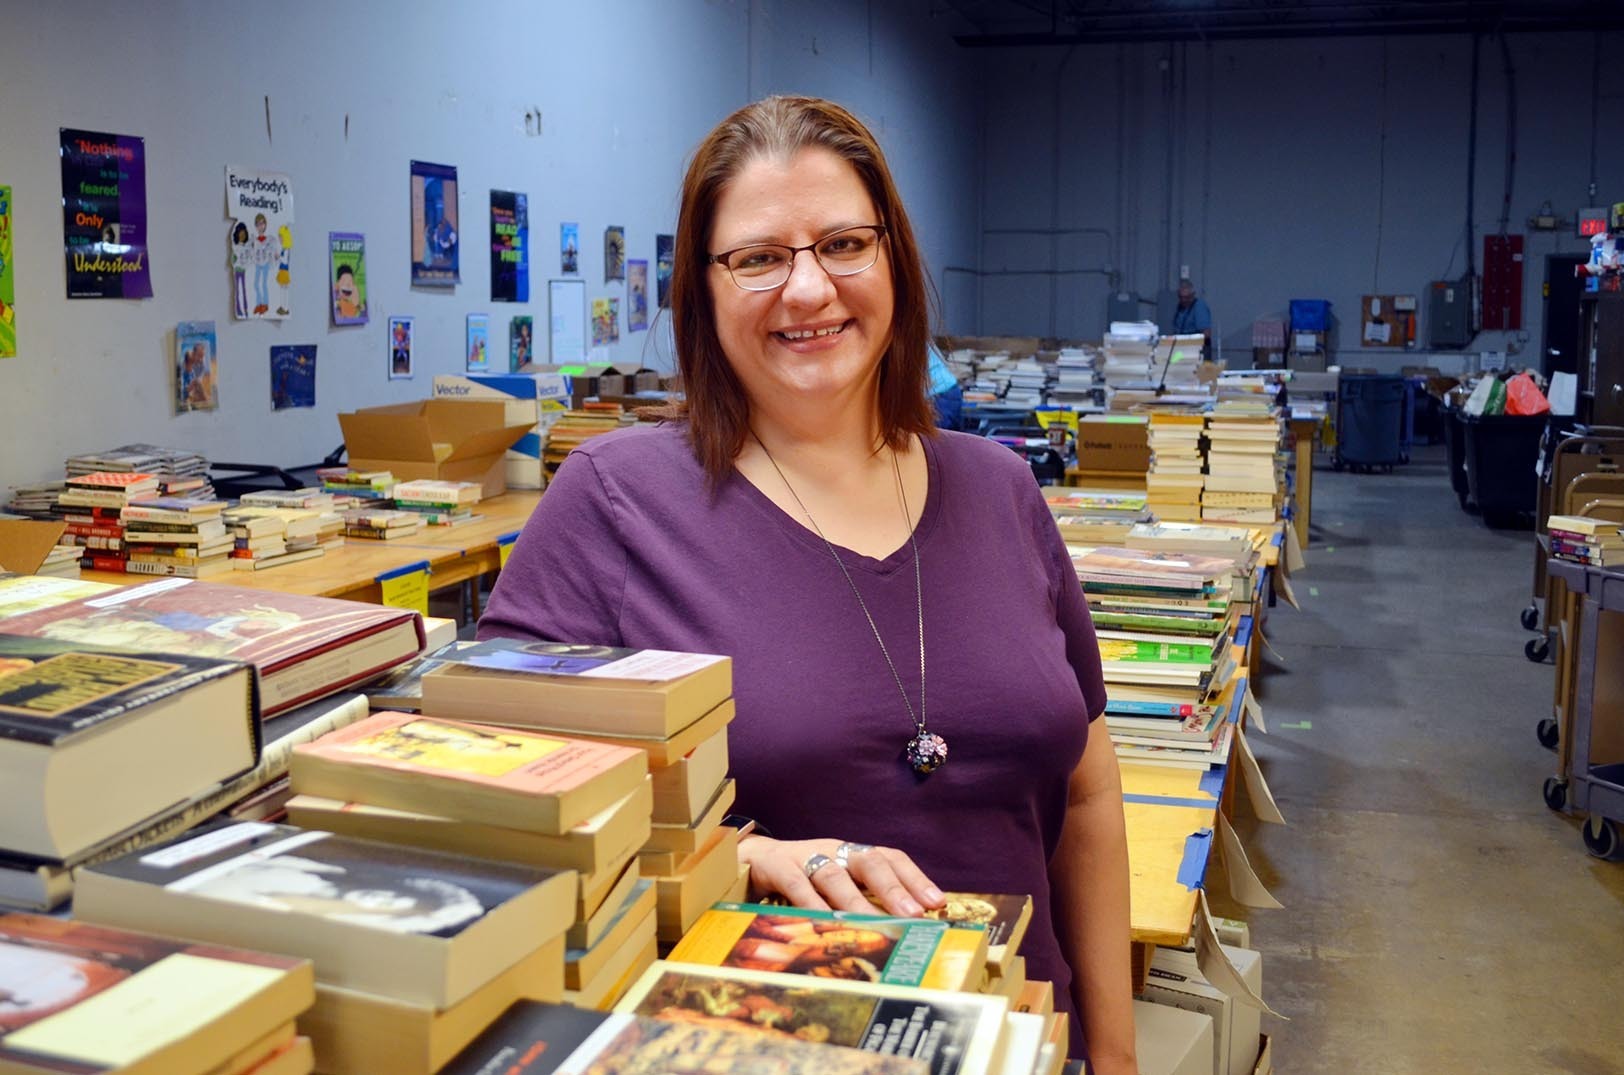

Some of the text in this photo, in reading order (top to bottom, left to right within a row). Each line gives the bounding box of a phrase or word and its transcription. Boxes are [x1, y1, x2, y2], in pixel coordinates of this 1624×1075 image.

[229, 174, 288, 196] Everybody's
[239, 193, 283, 213] Reading!
[75, 211, 104, 230] Only
[436, 383, 471, 396] Vector
